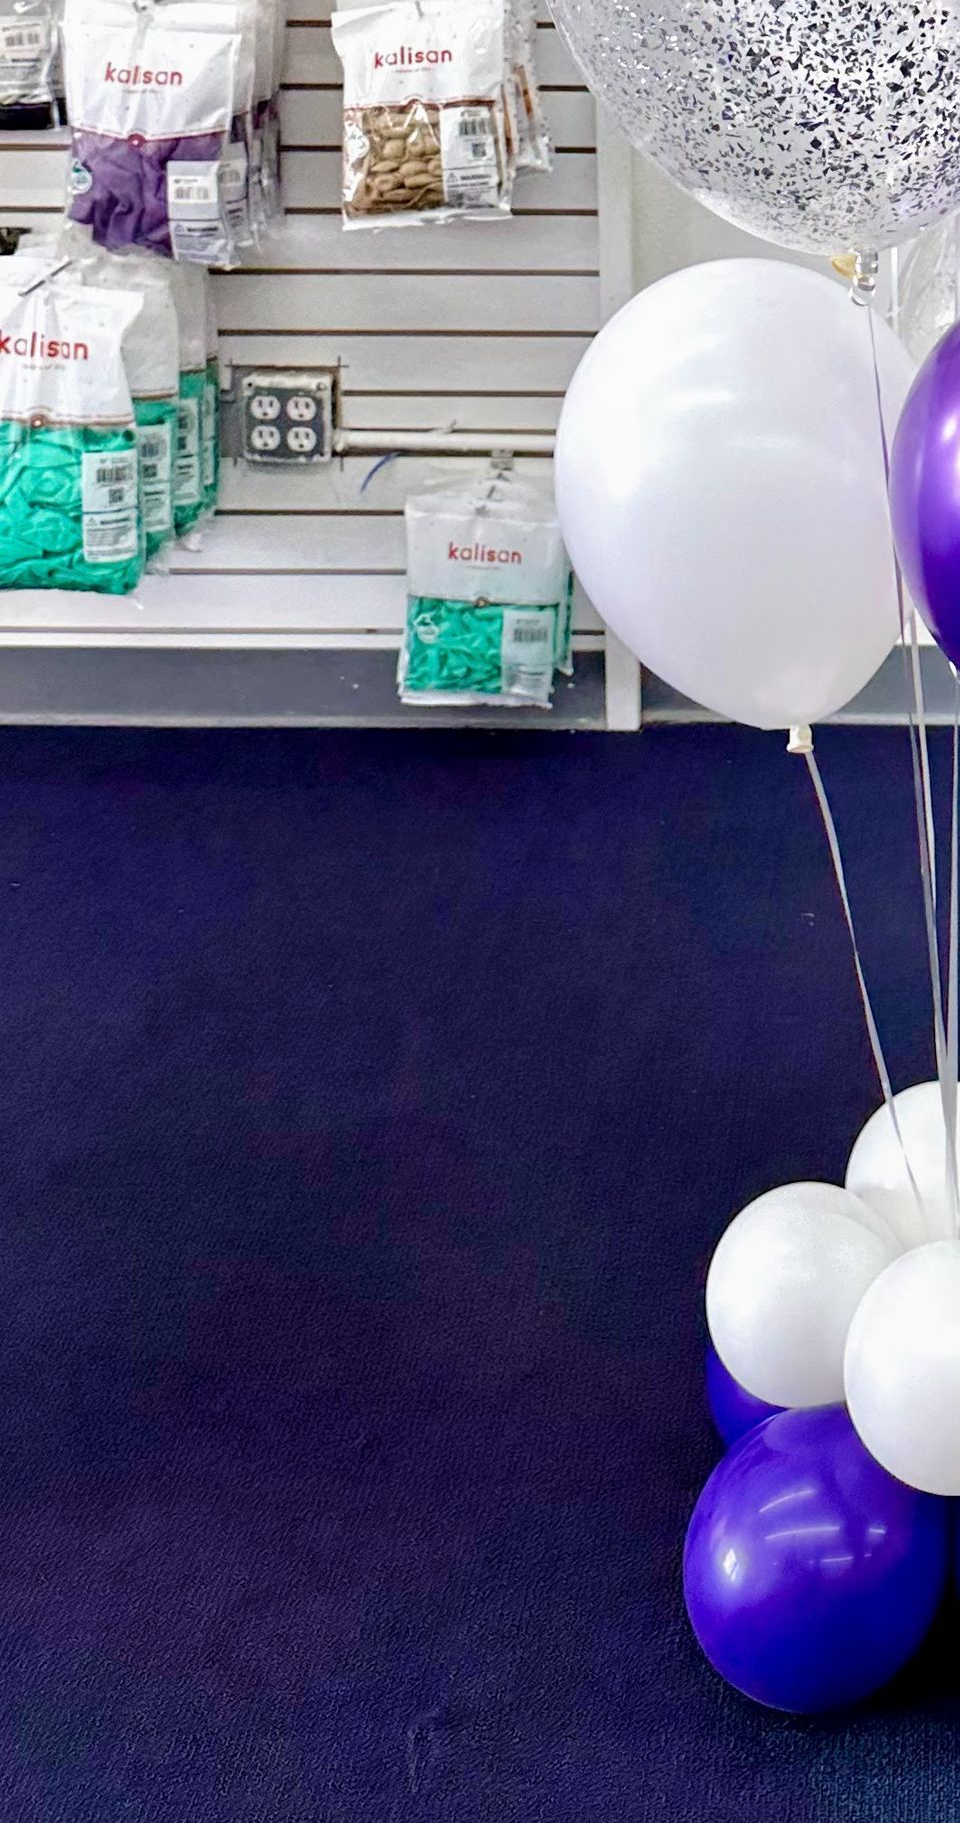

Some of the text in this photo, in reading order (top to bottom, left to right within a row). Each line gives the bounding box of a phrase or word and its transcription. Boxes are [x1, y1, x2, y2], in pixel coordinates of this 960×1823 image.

[374, 45, 453, 70] kalisan
[104, 61, 183, 86] kalsan
[0, 328, 89, 361] kalisan
[448, 541, 523, 565] kalisan
